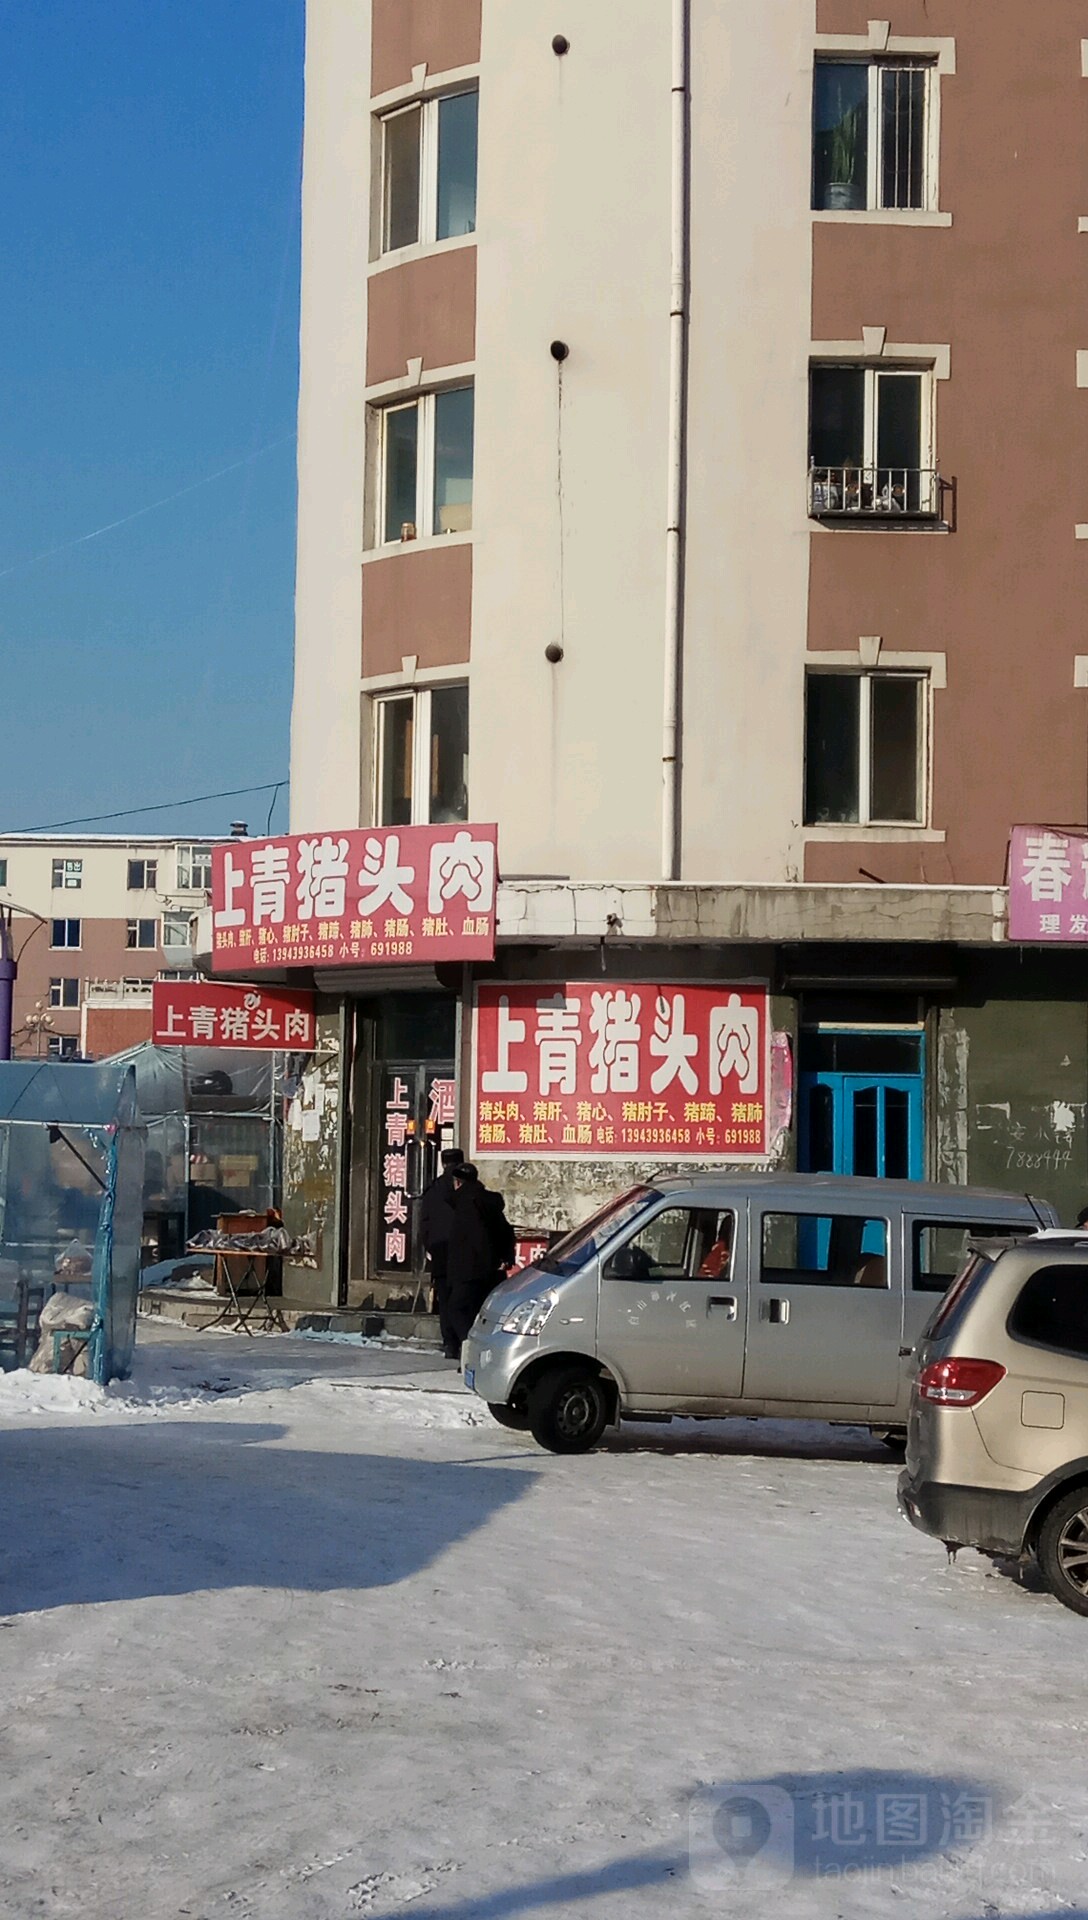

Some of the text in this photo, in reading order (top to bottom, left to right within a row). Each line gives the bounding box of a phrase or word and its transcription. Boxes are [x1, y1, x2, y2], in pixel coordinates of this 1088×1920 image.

[214, 831, 494, 928] 上青猪头肉
[1021, 832, 1088, 902] 春
[156, 1004, 310, 1043] 上青猪头肉
[482, 989, 758, 1096] 上青猪头肉
[383, 1077, 409, 1263] 上青猪头肉
